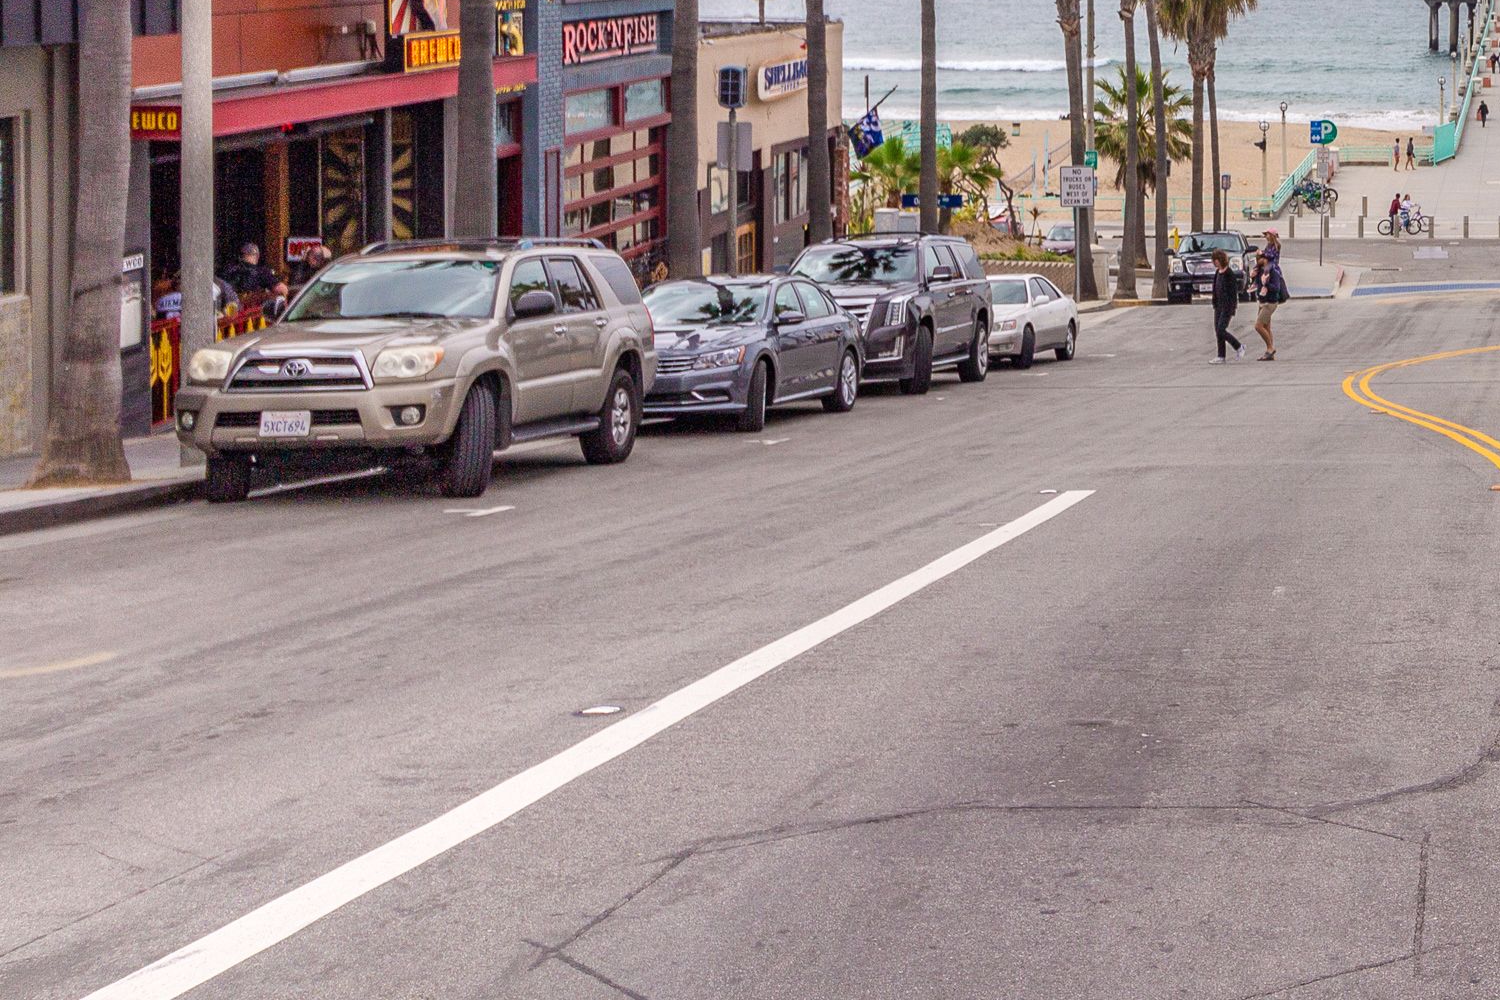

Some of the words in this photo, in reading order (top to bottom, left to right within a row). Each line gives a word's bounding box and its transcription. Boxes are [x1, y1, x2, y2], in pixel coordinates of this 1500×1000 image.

[411, 34, 461, 67] BREWCO
[1321, 122, 1333, 140] P
[263, 420, 306, 433] 5XCT694
